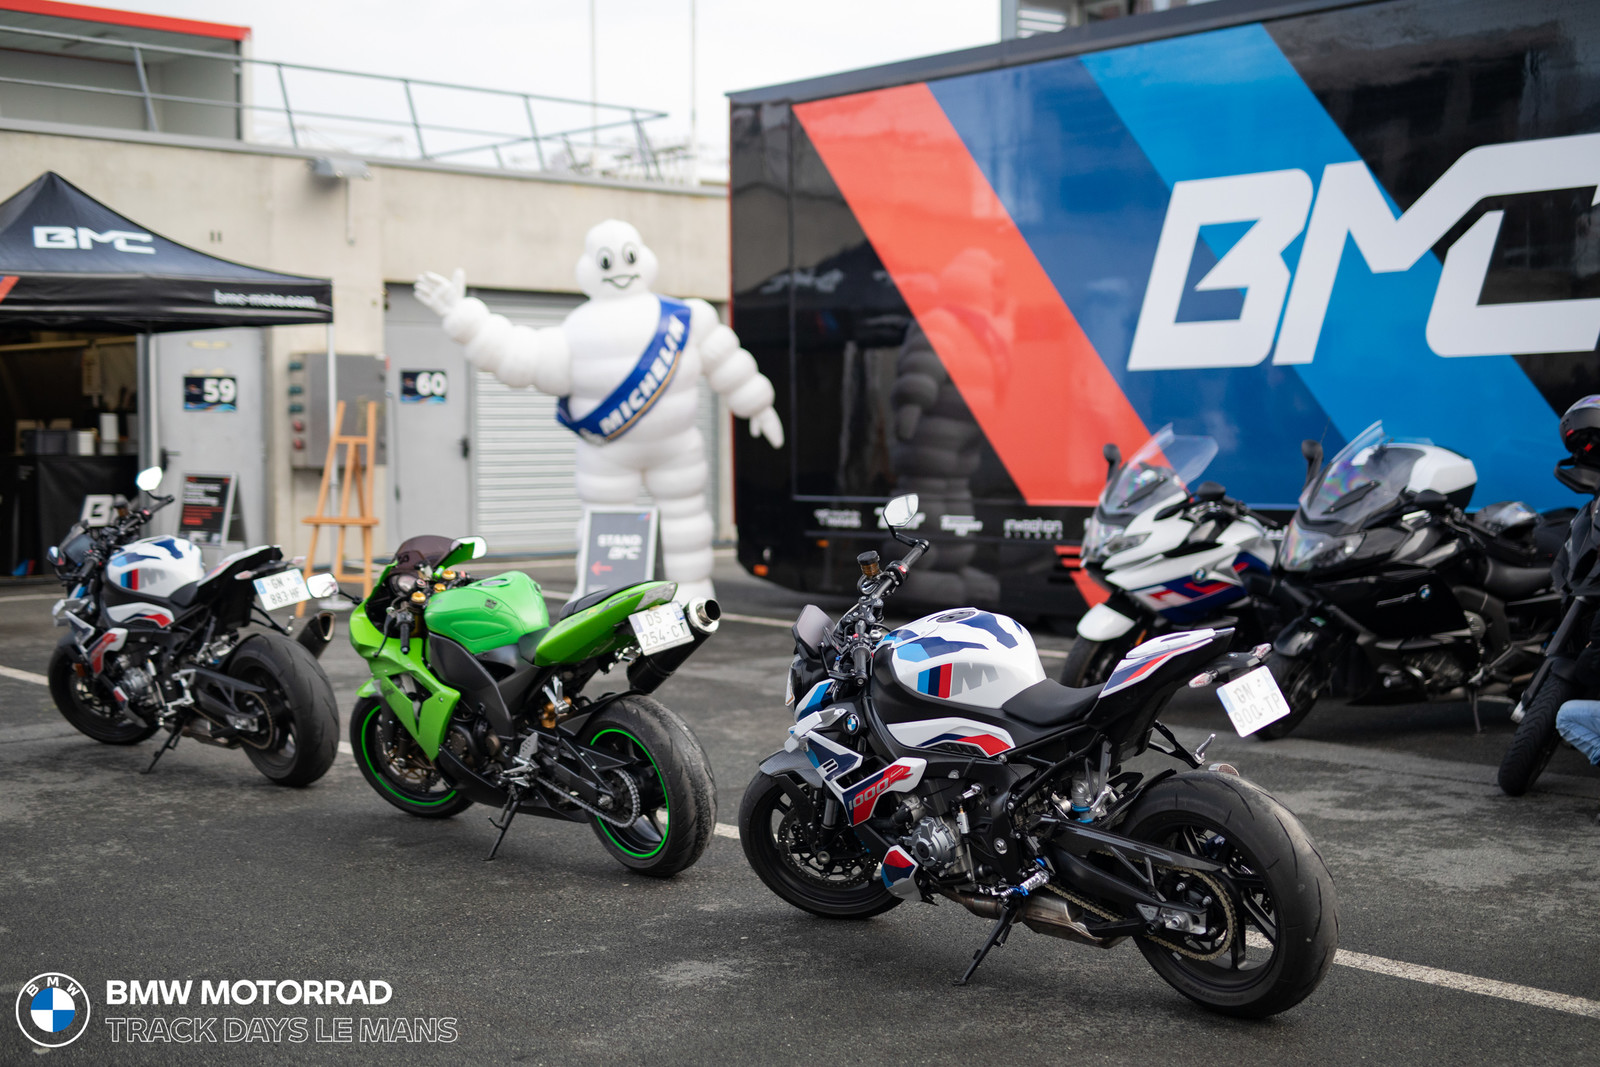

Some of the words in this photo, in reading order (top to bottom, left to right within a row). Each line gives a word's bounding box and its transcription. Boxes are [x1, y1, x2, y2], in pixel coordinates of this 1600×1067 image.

[32, 226, 156, 254] BMC
[1127, 133, 1600, 372] BMC
[416, 371, 446, 396] 60
[598, 312, 686, 435] MICHELIN
[203, 378, 236, 403] 59
[597, 534, 643, 547] STAND
